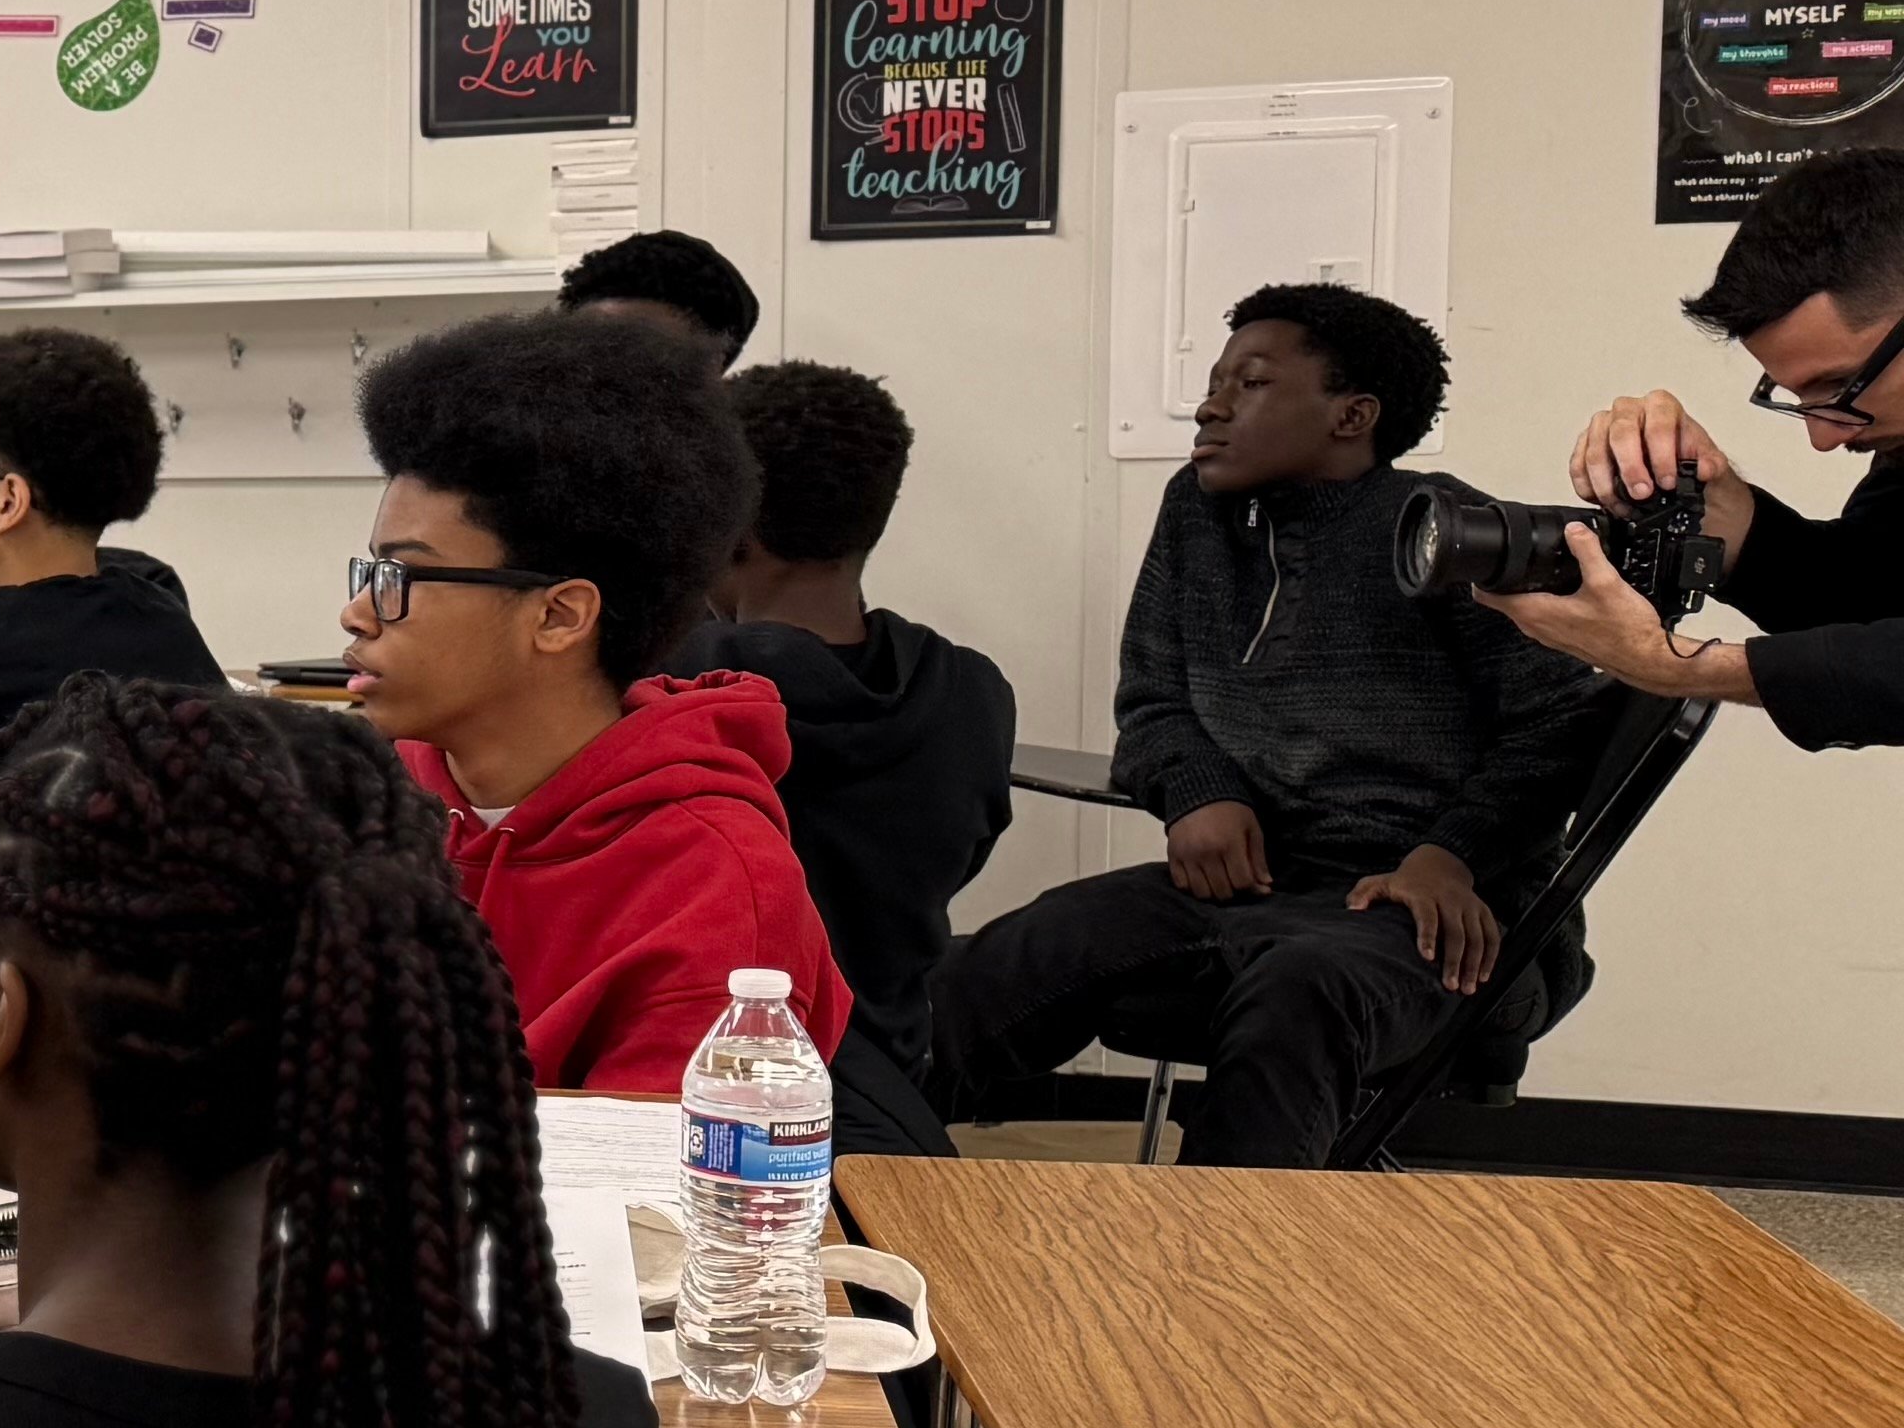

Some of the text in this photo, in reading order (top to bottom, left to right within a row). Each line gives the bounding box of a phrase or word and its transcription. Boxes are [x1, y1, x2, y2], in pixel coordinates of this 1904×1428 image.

[1764, 4, 1847, 26] MYSELF
[61, 12, 123, 68] SOLVER
[459, 14, 597, 96] Learn
[536, 26, 590, 46] YOU
[845, 0, 1030, 78] learning
[70, 24, 149, 96] PROBLEM
[104, 60, 147, 97] BE A
[884, 59, 988, 80] BECAUSE LIFE
[883, 77, 987, 116] NEVER
[1789, 80, 1835, 90] reactions
[884, 110, 986, 154] STOPS
[842, 130, 1026, 210] teaching
